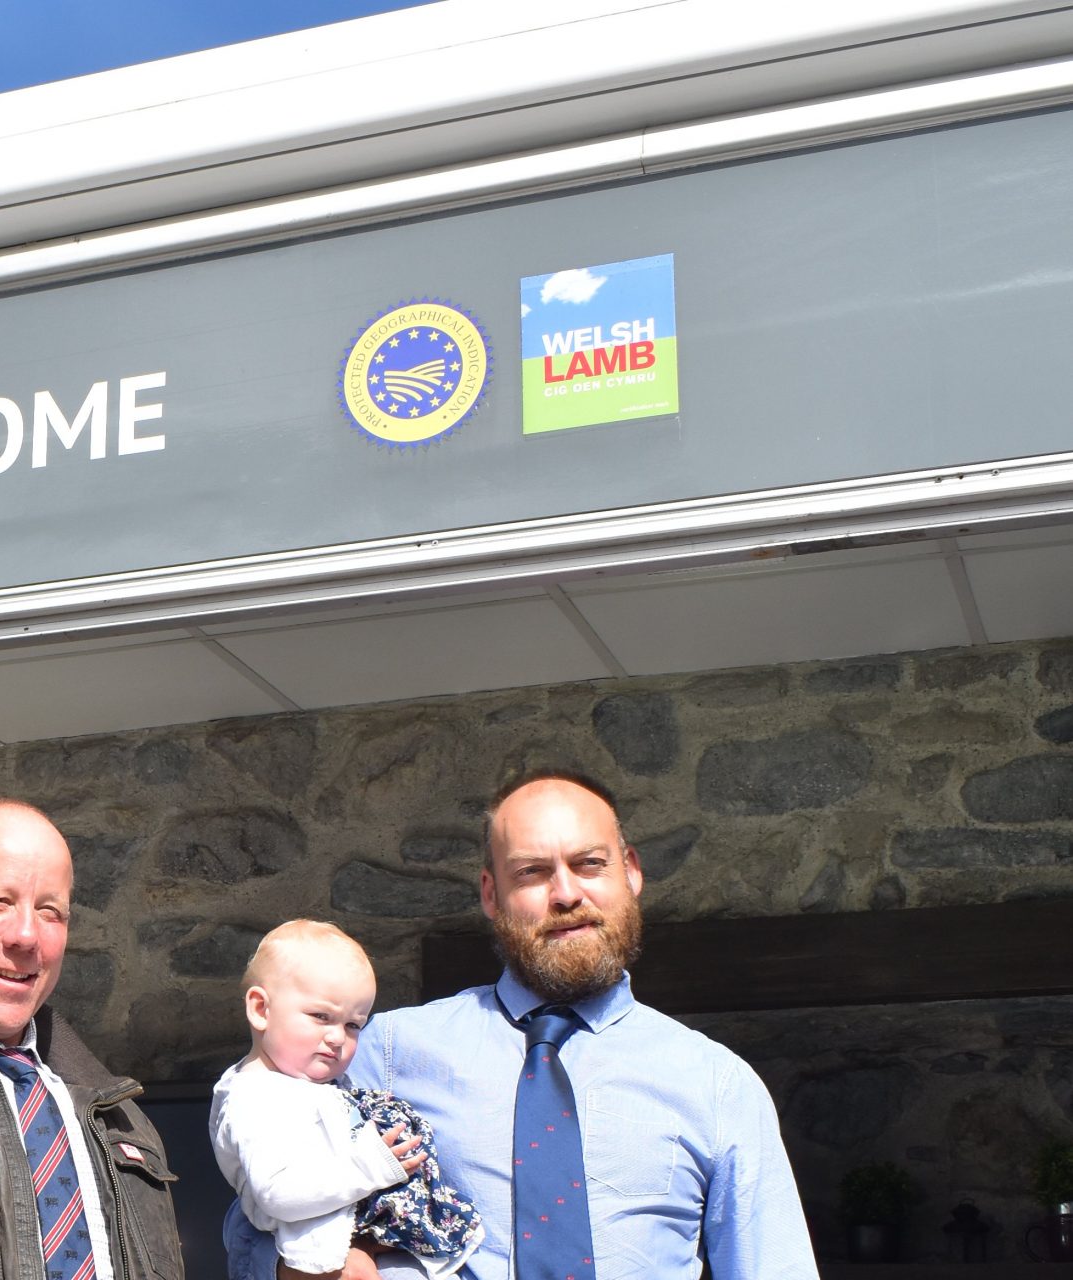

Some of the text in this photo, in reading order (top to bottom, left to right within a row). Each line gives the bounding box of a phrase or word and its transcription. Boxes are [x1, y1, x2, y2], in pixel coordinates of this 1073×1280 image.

[542, 317, 655, 356] WELSH
[352, 309, 480, 428] PROTECTED GEOGRAPHICAL INDICATION
[544, 340, 656, 384] LAMB
[544, 384, 567, 397] CIG
[606, 372, 656, 388] CYMRU
